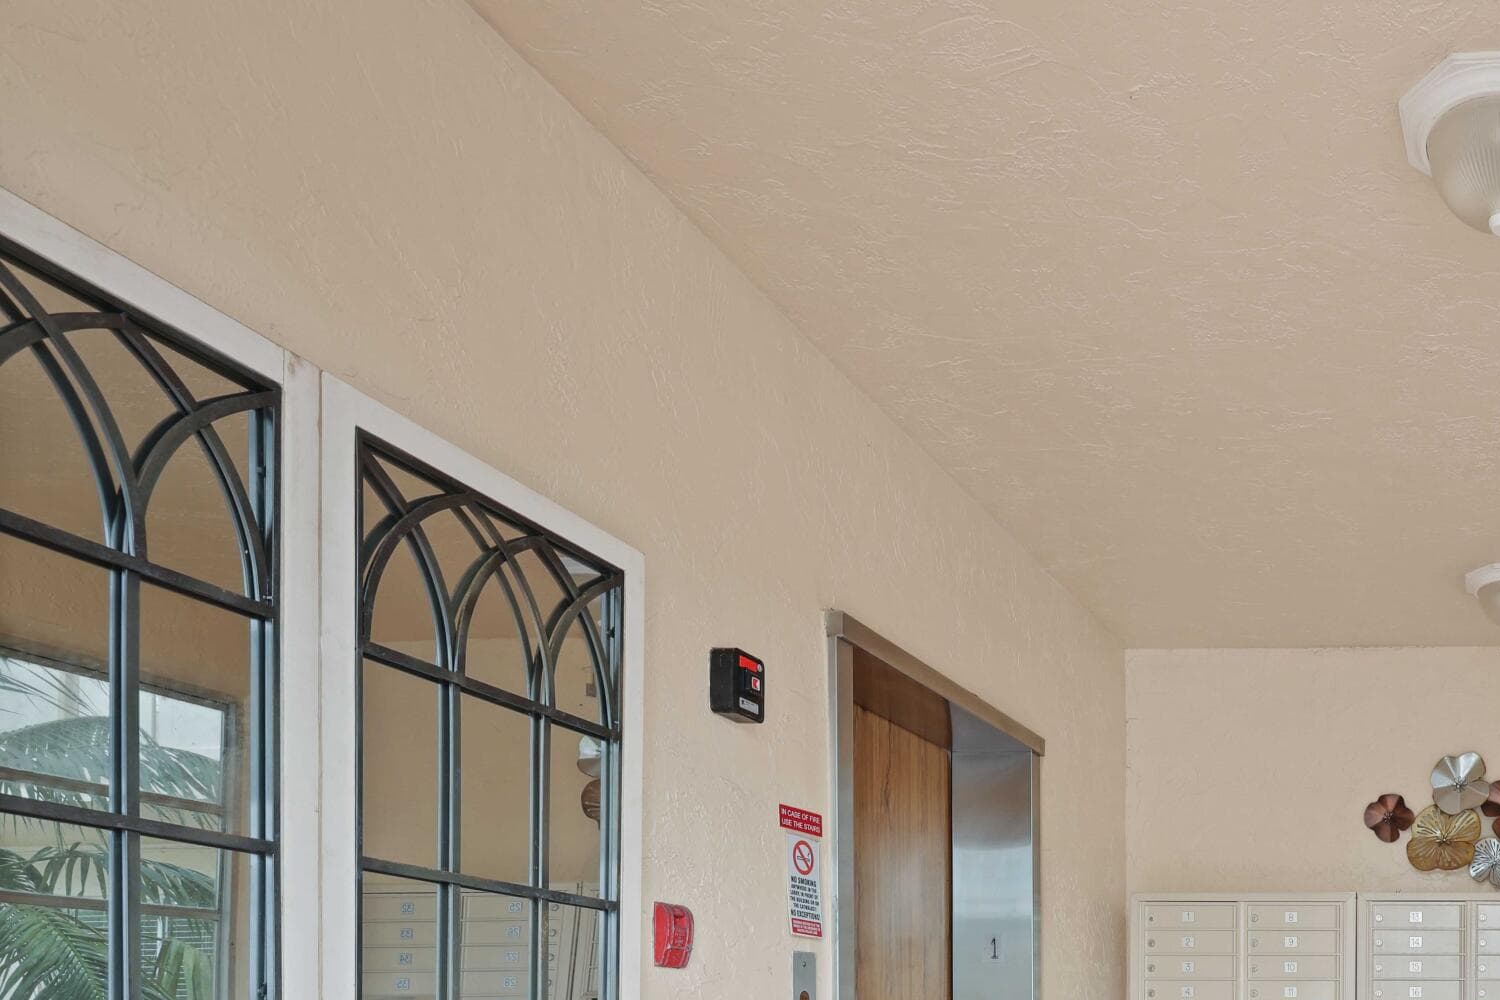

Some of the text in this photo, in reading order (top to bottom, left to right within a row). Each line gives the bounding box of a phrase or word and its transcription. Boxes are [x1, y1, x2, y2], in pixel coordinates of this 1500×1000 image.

[781, 808, 787, 816] IN
[788, 810, 801, 820] CASE
[810, 815, 820, 824] FIRE
[782, 817, 792, 827] USE
[793, 820, 803, 829] THE
[791, 875, 816, 888] NO SMOKING
[1289, 913, 1293, 921] 8
[1412, 913, 1419, 921] 13
[1186, 938, 1190, 946] 2
[1412, 938, 1419, 946] 14
[990, 937, 999, 959] 1
[1412, 988, 1419, 996] 16
